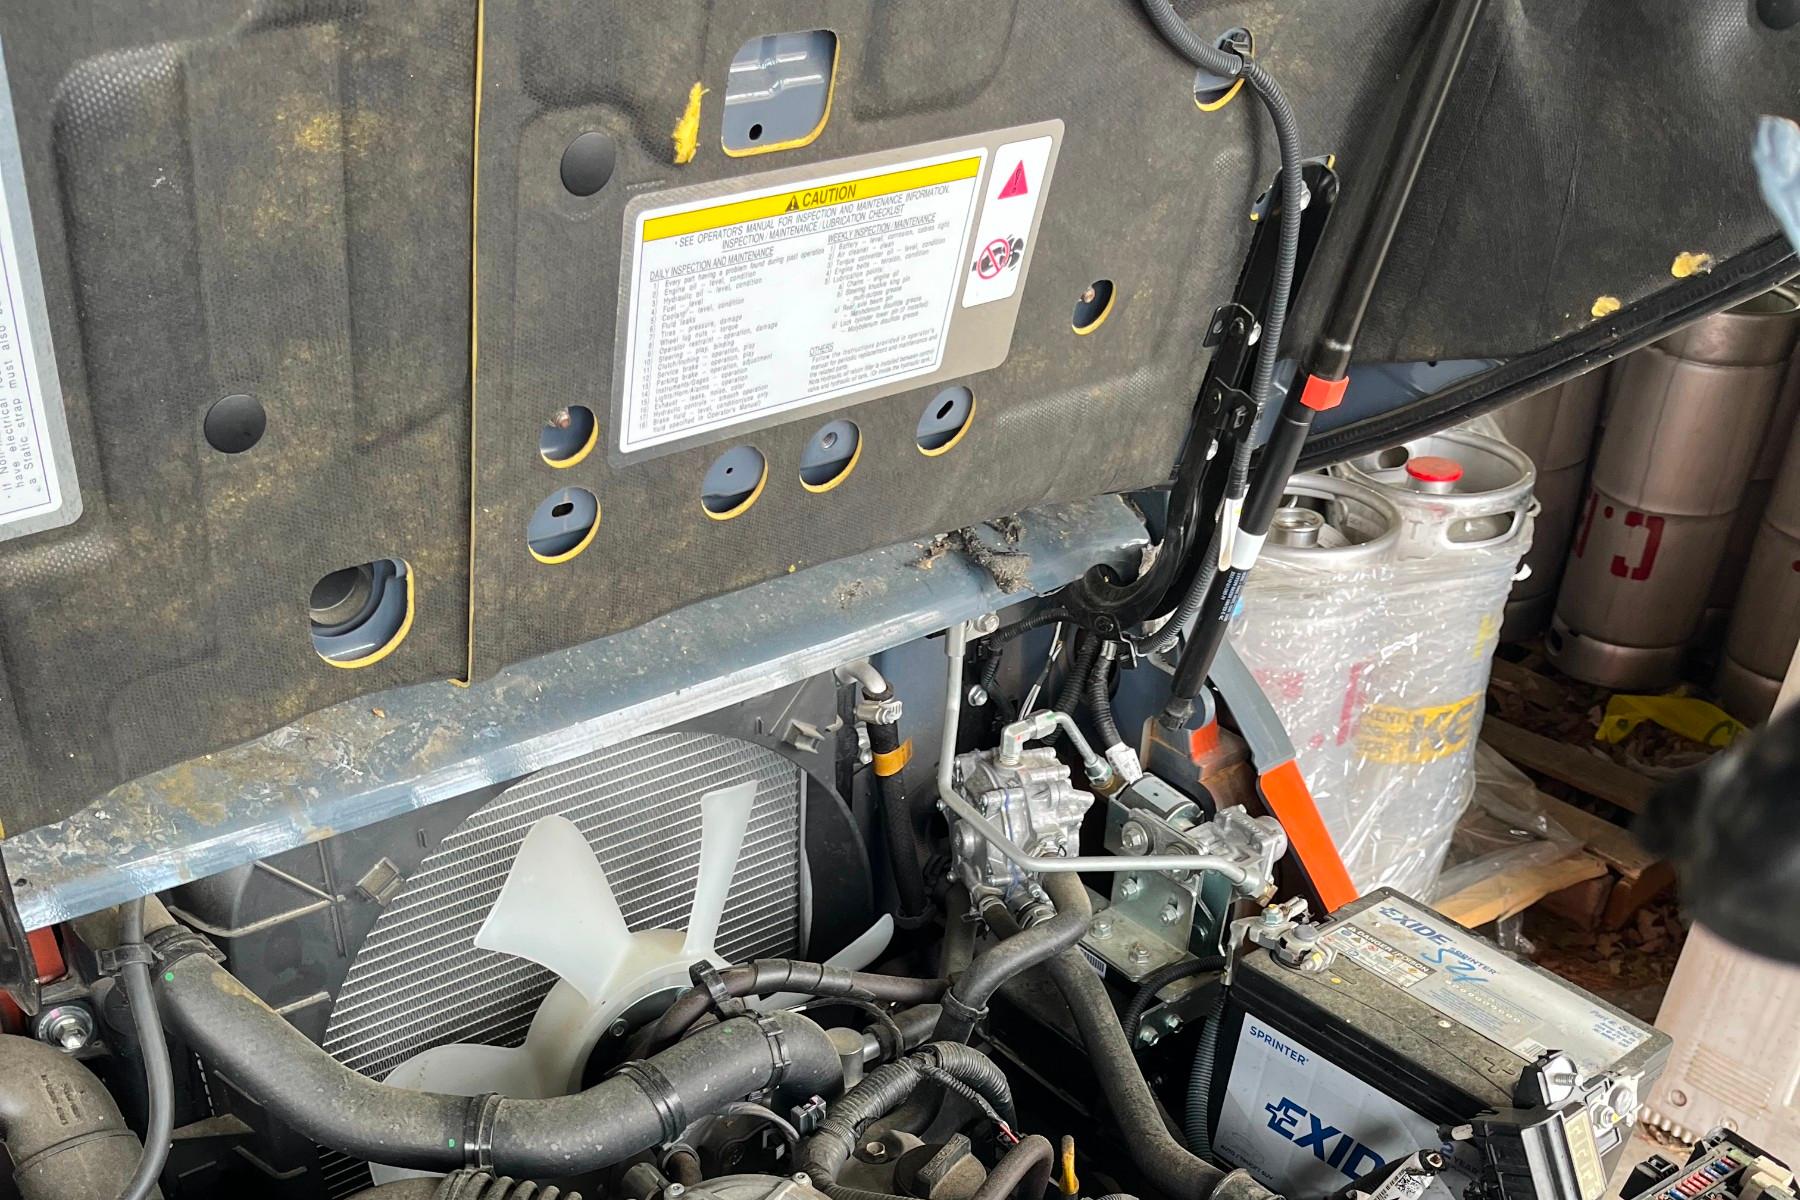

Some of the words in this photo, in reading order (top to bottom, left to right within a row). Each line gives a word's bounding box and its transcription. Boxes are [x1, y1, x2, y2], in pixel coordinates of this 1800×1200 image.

[801, 183, 856, 207] CAUTION
[679, 235, 695, 247] SEE
[697, 225, 742, 244] OPERATOR'S
[745, 219, 774, 234] MANUAL
[777, 215, 793, 228] FOR
[795, 207, 837, 224] INSPECTION
[839, 203, 854, 215] AND
[856, 194, 903, 212] MAINTENANCE
[722, 232, 764, 249] INSPECTION
[768, 221, 817, 240] MAINTENANCE
[821, 211, 866, 229] LUBRICATION
[868, 204, 904, 220] CHECKLIST
[827, 229, 853, 243] WEEKLY
[855, 221, 892, 237] INSPECTION
[893, 212, 936, 229] MAINTENANCE
[649, 267, 669, 280] DAILY
[670, 259, 709, 276] INSPECTION
[711, 256, 726, 268] AND
[728, 246, 773, 264] MAINTENANCE
[809, 342, 834, 356] OTHERS
[4, 360, 18, 389] must
[13, 399, 25, 428] strap
[24, 436, 34, 469] Static
[15, 461, 24, 488] have
[1379, 906, 1453, 946] EXIDE
[1449, 947, 1498, 975] SPRINTER
[1250, 1026, 1309, 1066] SPRINTER
[1265, 1096, 1386, 1181] EXID
